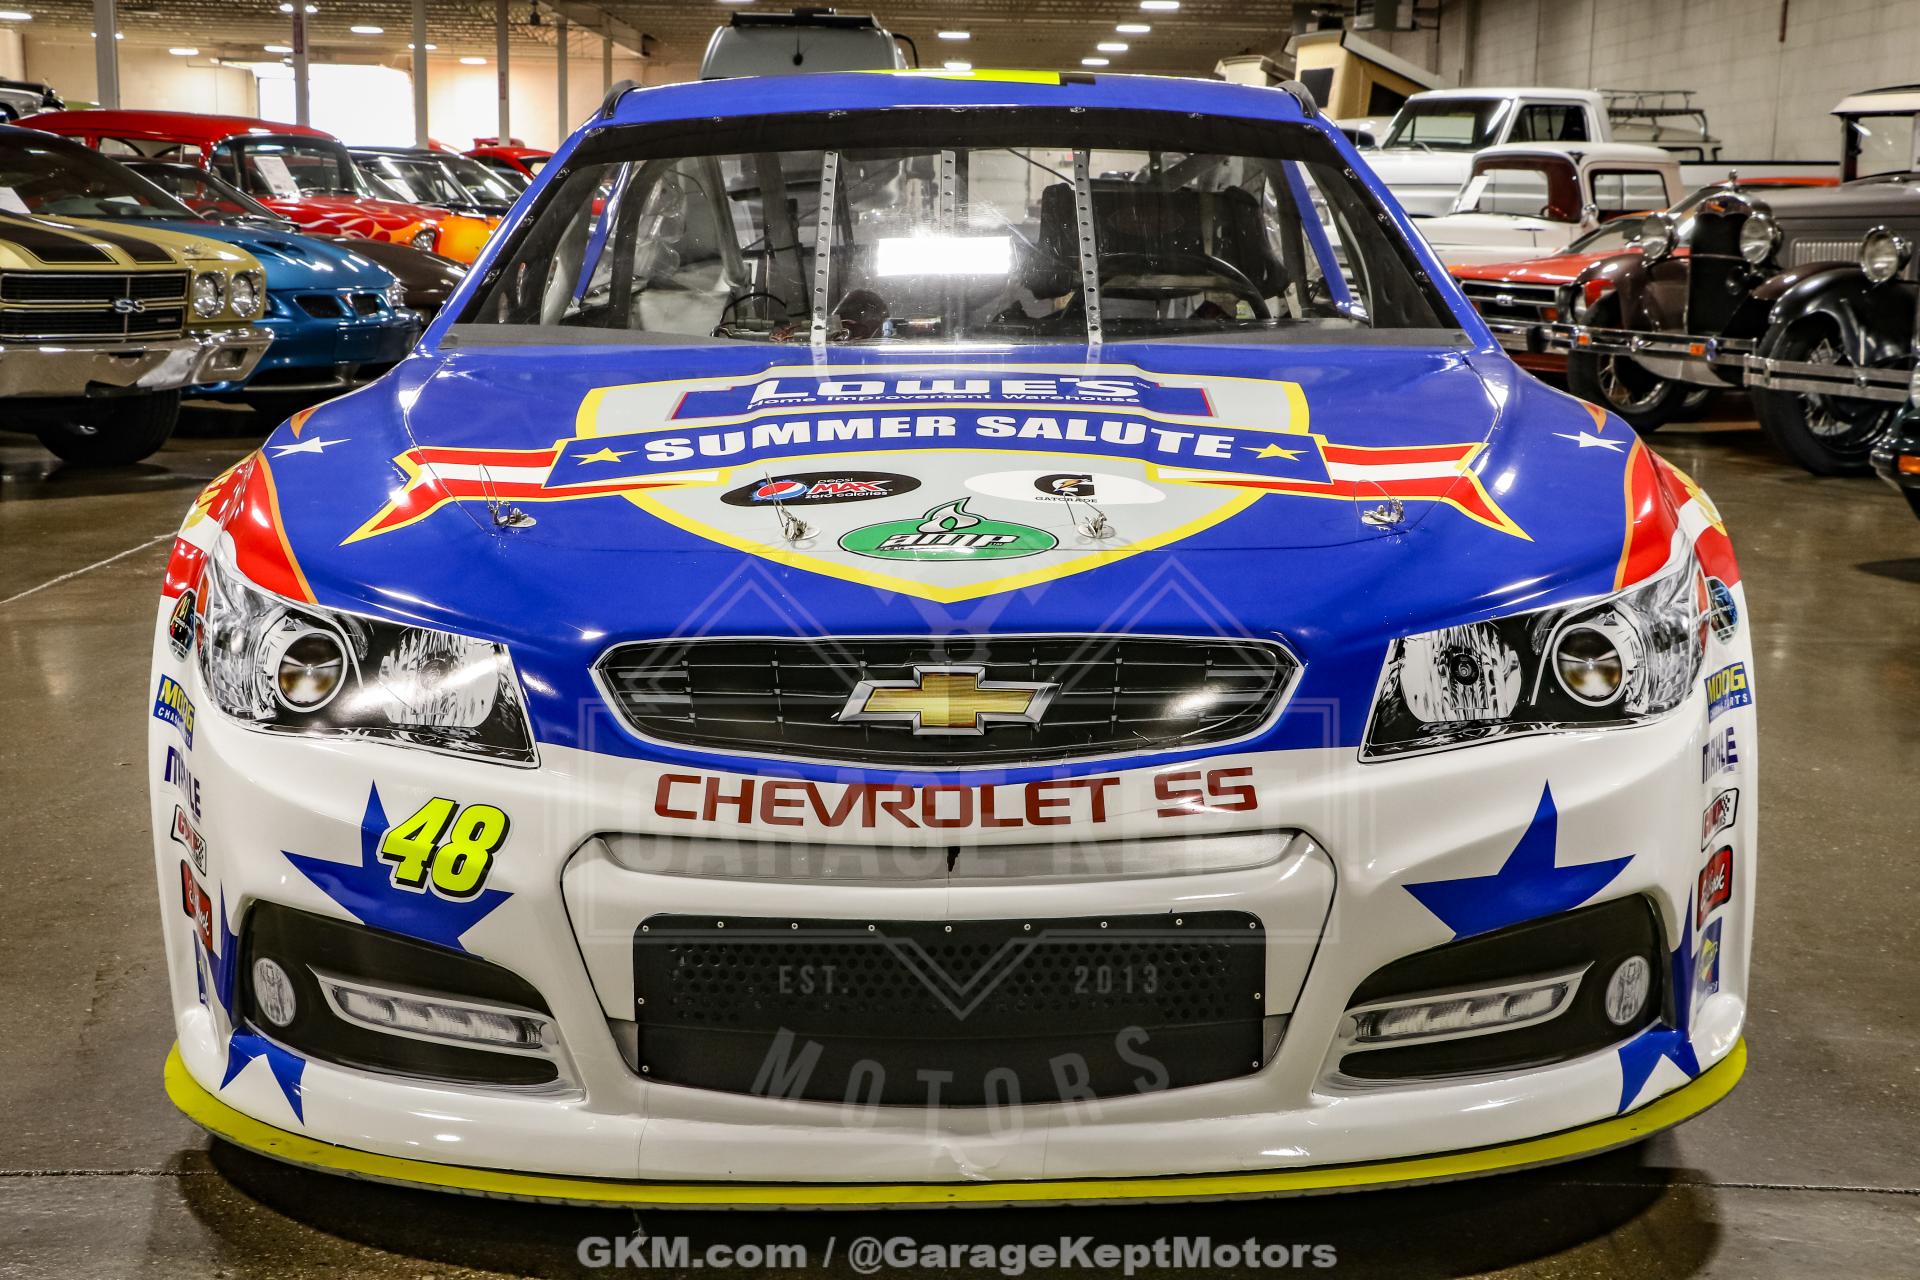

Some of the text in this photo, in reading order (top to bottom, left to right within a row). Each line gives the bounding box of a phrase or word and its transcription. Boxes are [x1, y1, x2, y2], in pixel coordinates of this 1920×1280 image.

[113, 299, 146, 314] SS
[747, 392, 1141, 410] Home Improvement Warehouse
[750, 377, 1140, 403] LOWE'S
[644, 415, 1235, 462] SUMMER SALUTE
[806, 480, 893, 495] MAX
[836, 490, 888, 498] calories
[1707, 665, 1747, 706] MOOG
[158, 679, 195, 733] MOOG
[654, 766, 1258, 829] CHEVROLET SS
[381, 796, 511, 898] 48
